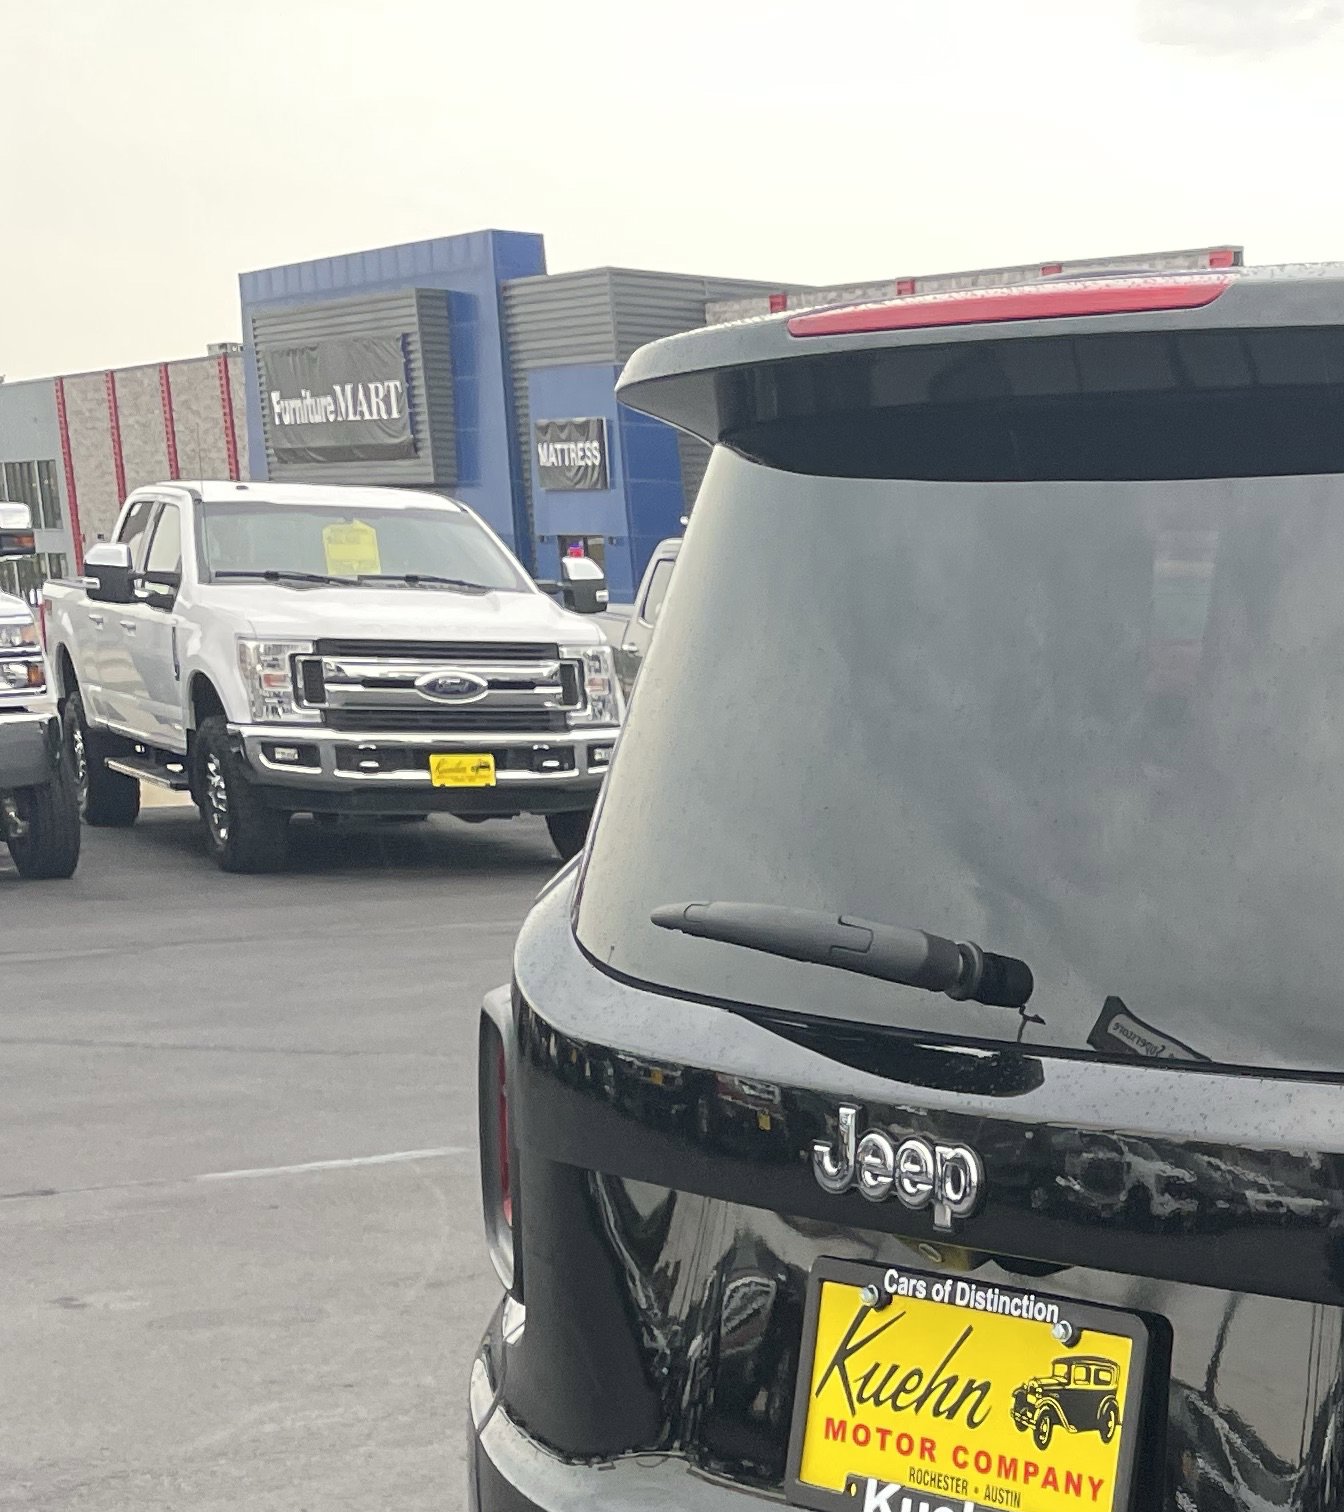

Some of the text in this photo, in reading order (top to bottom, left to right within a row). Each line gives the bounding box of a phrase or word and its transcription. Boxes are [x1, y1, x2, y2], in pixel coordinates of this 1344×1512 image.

[537, 440, 600, 467] MATTRESS
[813, 1105, 982, 1228] Jeep
[884, 1268, 1059, 1324] Cars of Distinction
[814, 1304, 992, 1429] Kuehn
[824, 1416, 1106, 1502] MOTOR COMPANY
[908, 1465, 1022, 1509] ROCHESTER AUSTIN
